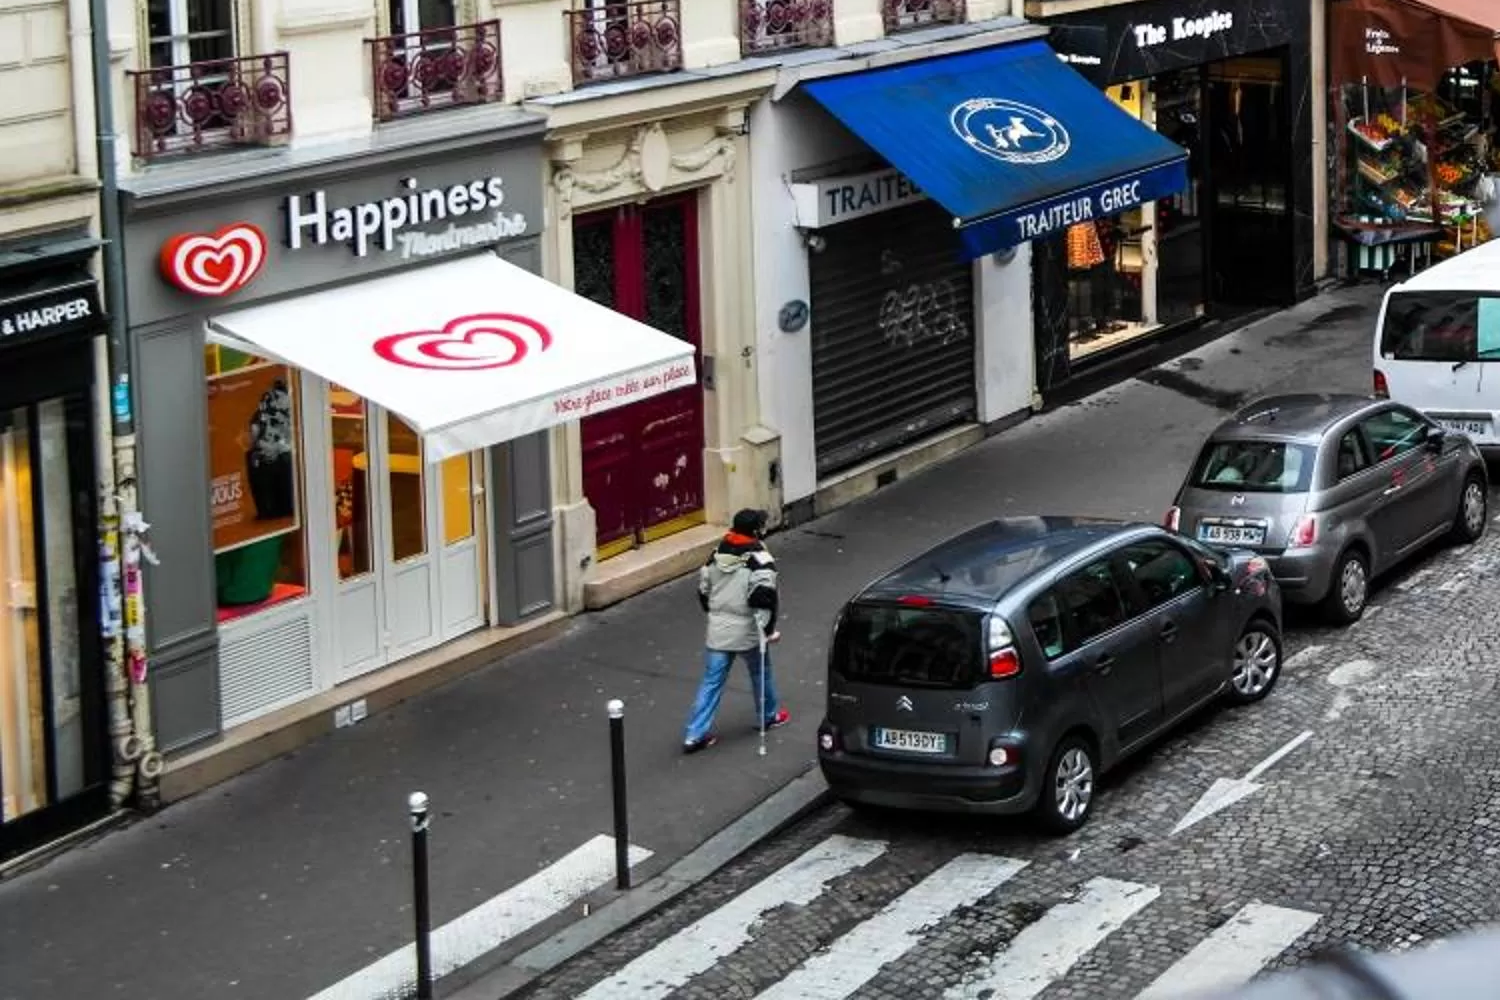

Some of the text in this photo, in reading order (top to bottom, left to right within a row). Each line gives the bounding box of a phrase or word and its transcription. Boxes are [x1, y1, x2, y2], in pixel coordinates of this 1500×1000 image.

[1135, 10, 1233, 48] The Kooples
[289, 177, 504, 257] Happiness
[1016, 180, 1141, 240] TRAITEUR GREC
[2, 297, 92, 335] & HARPER
